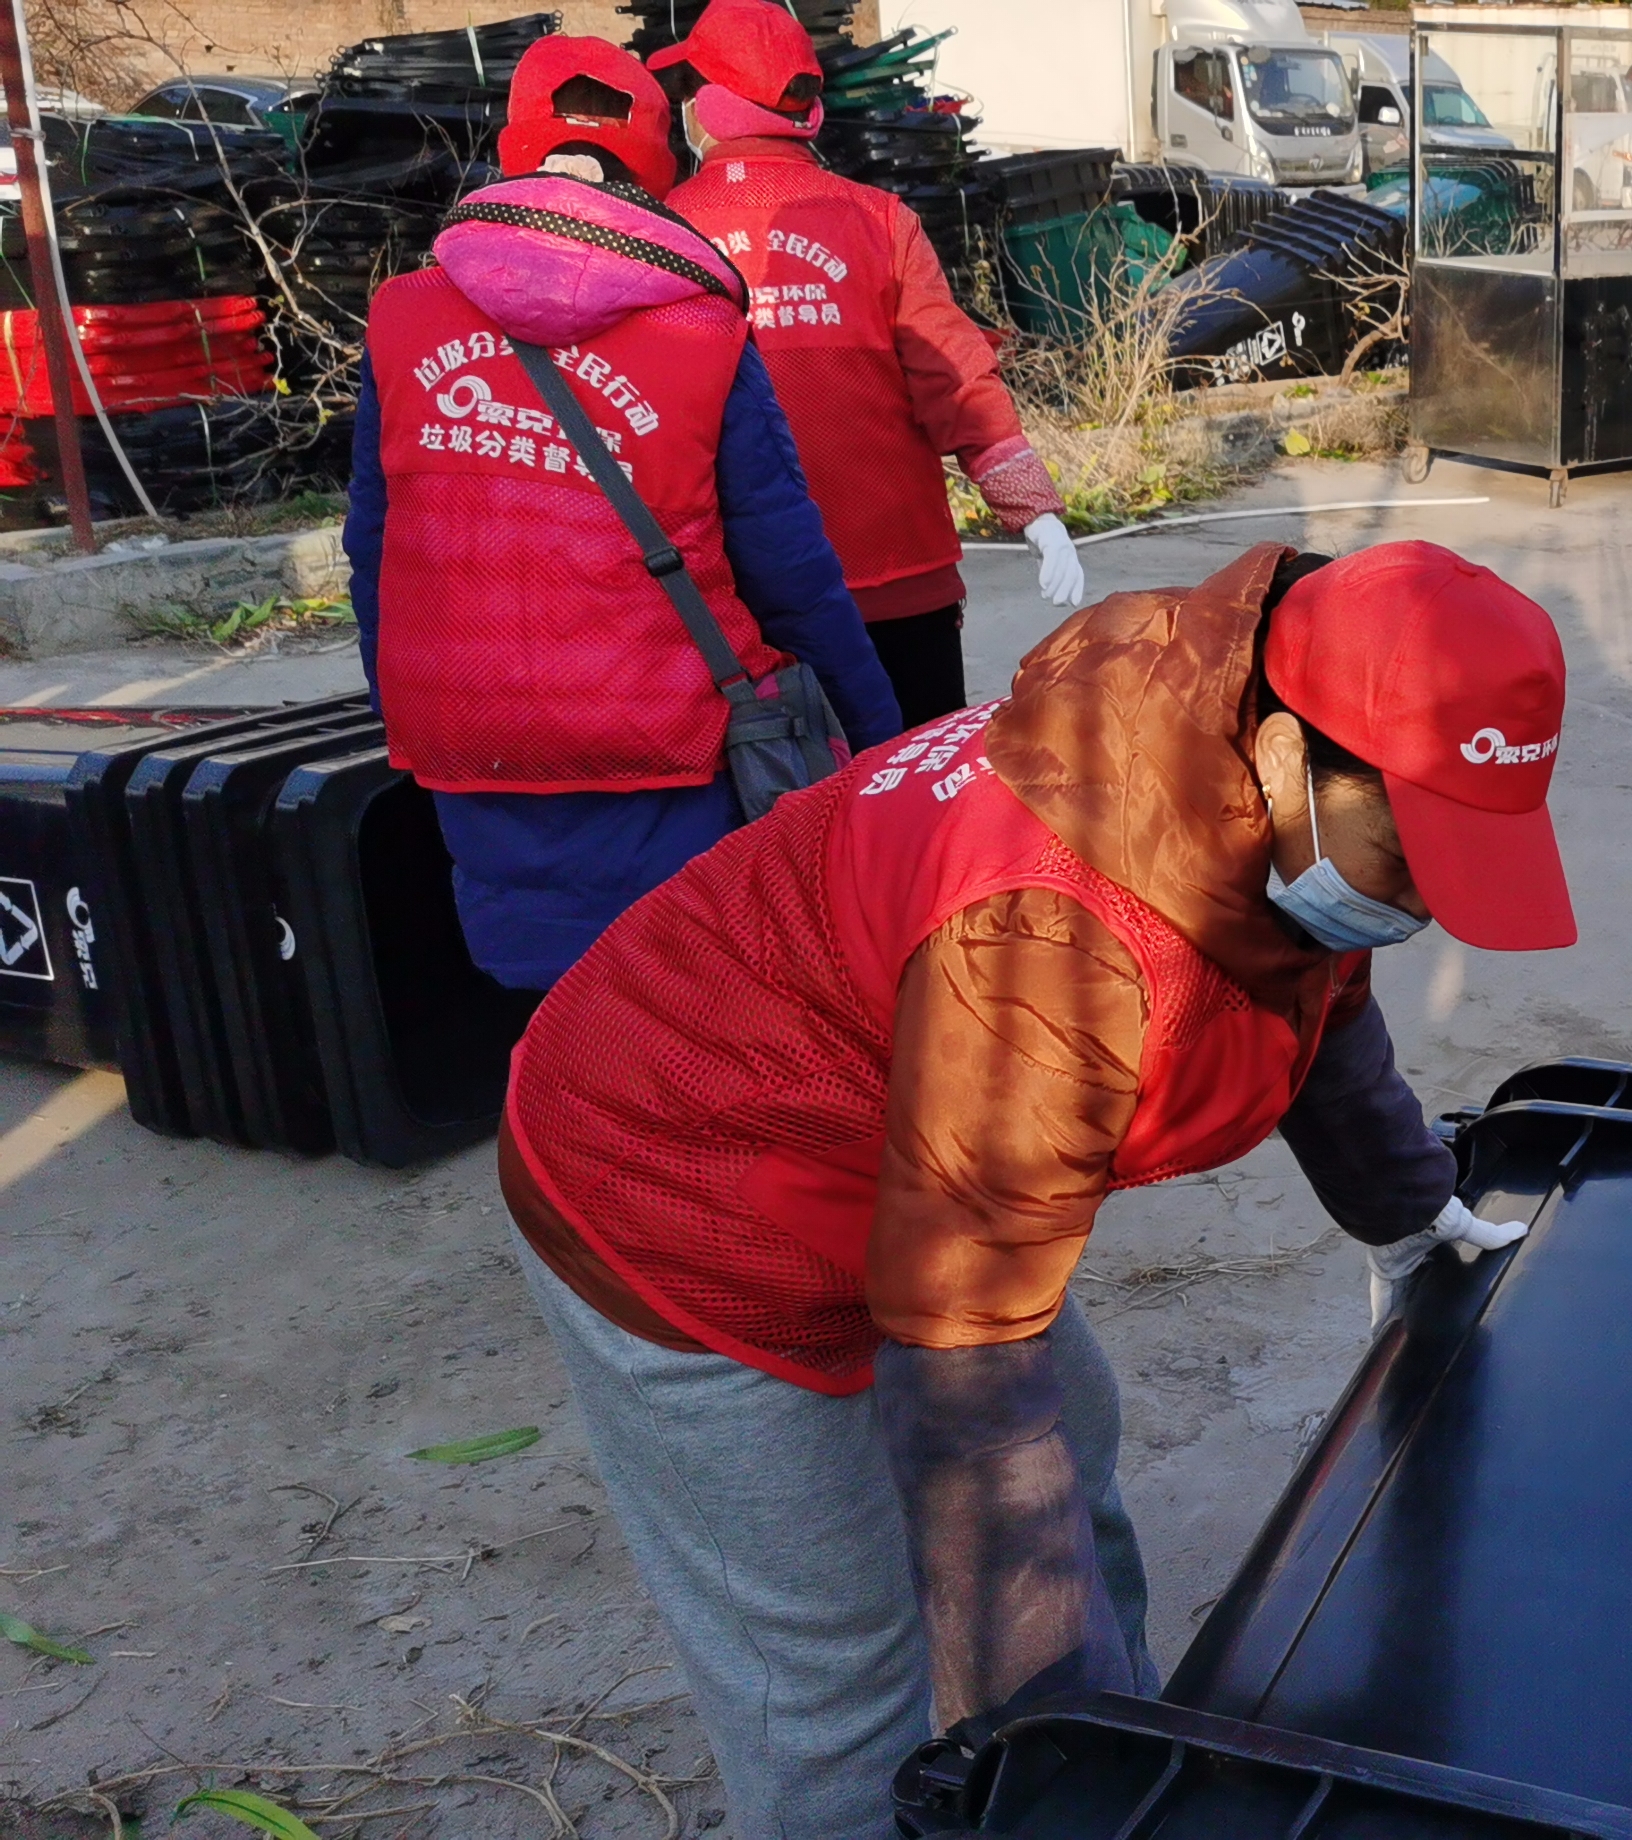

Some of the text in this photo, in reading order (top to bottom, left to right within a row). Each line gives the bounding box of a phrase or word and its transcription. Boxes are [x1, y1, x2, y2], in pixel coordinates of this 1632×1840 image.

[767, 229, 848, 283] 全民行动
[746, 302, 842, 329] 类督导员
[749, 283, 827, 306] 克环保
[552, 345, 660, 437] 全民行动
[475, 400, 622, 454] 索克保
